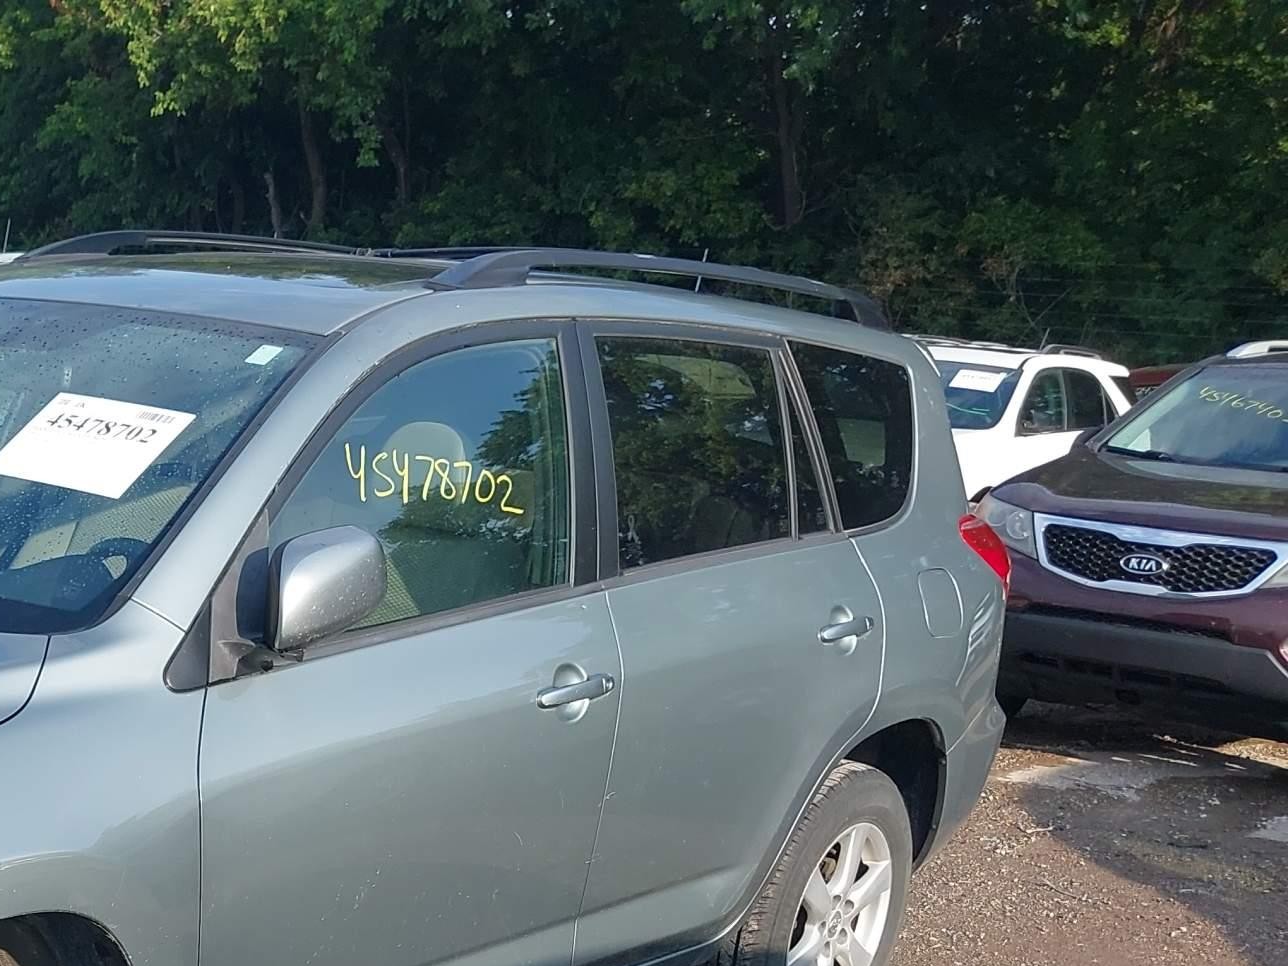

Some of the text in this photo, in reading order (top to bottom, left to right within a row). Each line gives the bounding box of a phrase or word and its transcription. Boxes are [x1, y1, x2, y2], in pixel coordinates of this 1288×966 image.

[1199, 385, 1288, 422] 4546740
[46, 411, 158, 444] 45478702
[344, 442, 525, 515] 45478702
[1128, 557, 1157, 572] KIA
